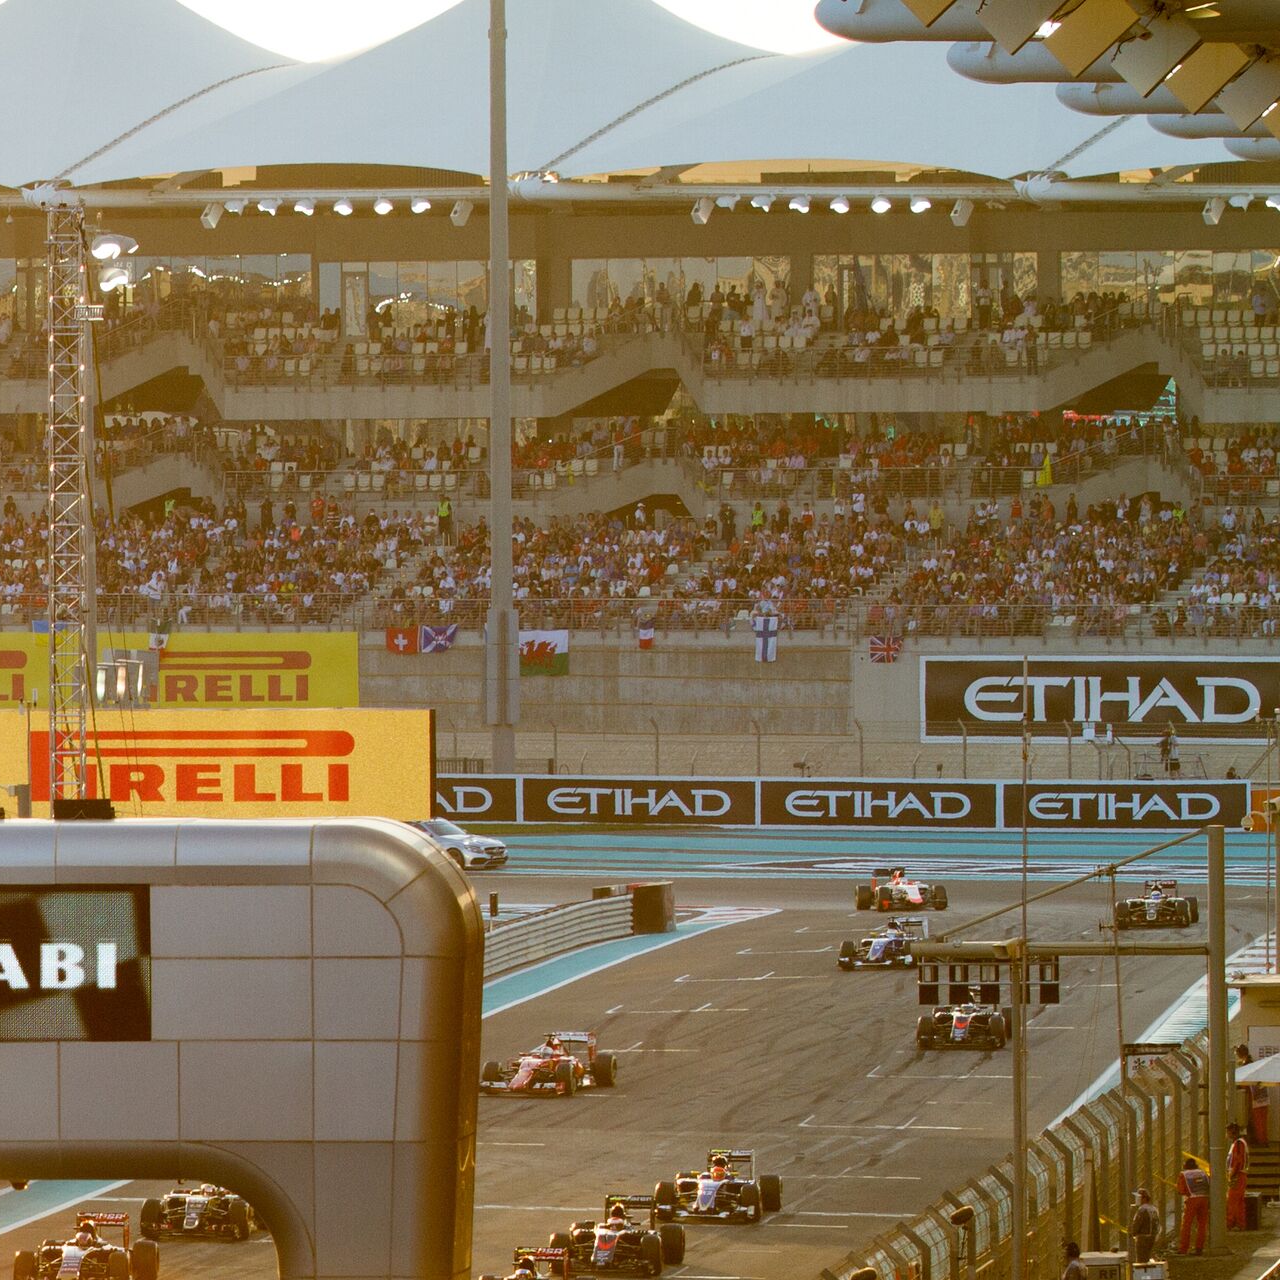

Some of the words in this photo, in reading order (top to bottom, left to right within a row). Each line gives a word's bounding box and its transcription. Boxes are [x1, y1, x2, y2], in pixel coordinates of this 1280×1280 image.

[964, 675, 1261, 724] ETIHAD
[31, 731, 355, 801] PIRELLI
[547, 787, 732, 816] ETIHAD
[785, 790, 971, 819] ETIHAD
[1027, 792, 1221, 821] ETIHAD
